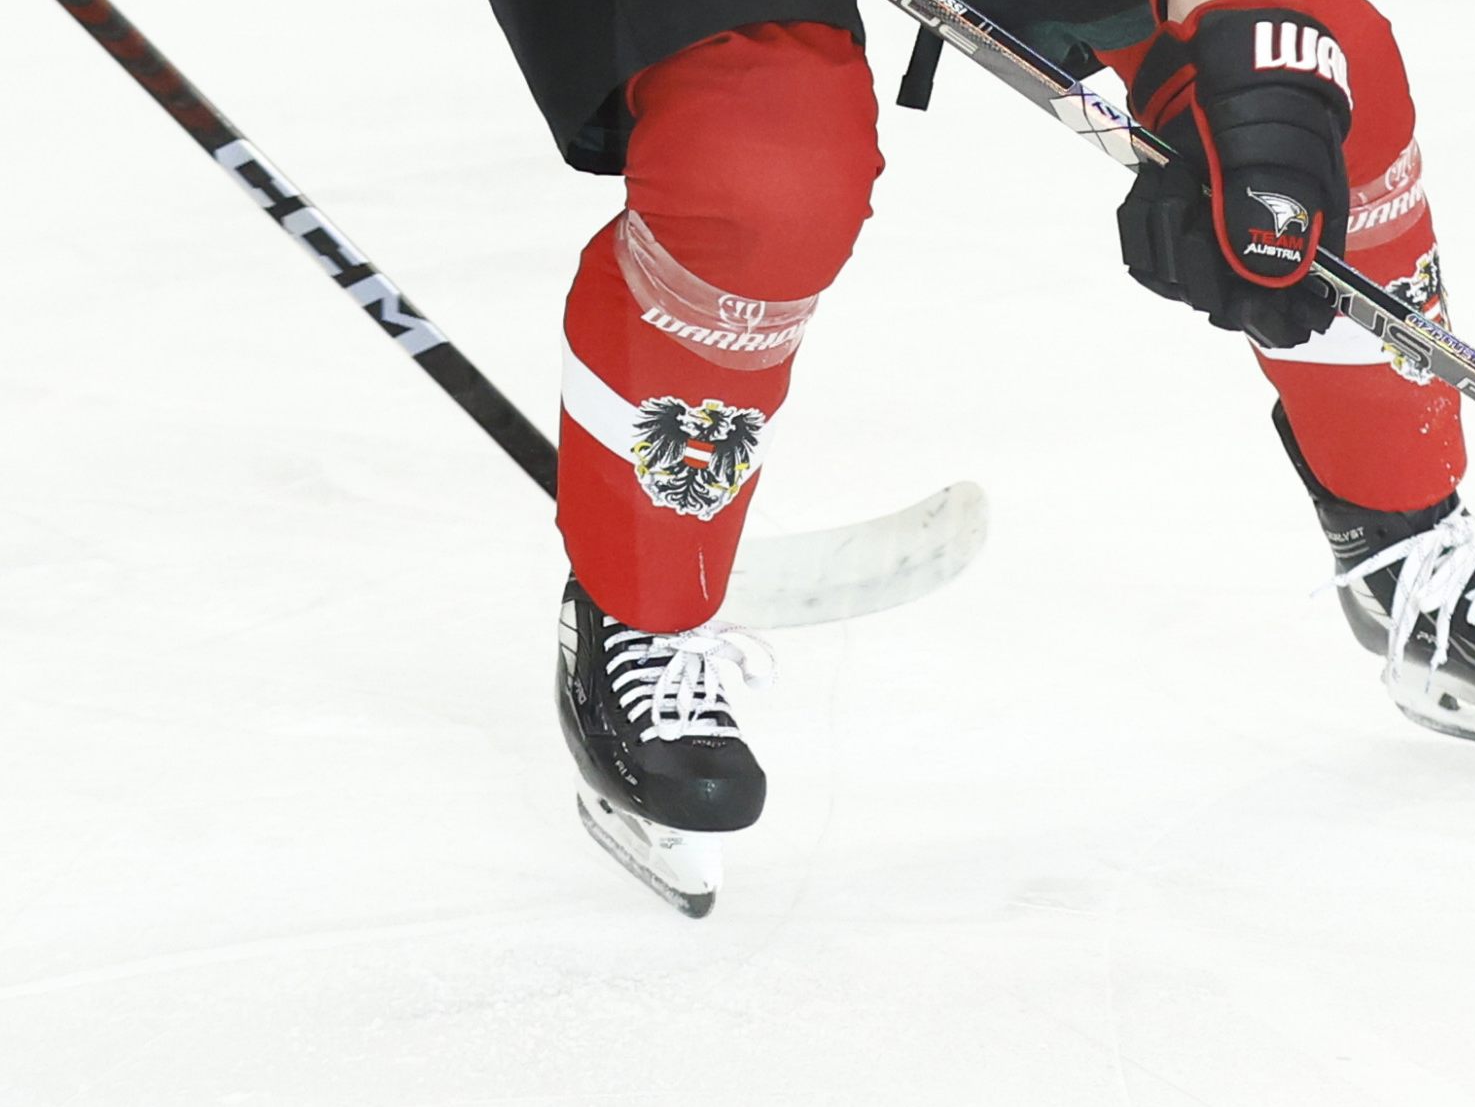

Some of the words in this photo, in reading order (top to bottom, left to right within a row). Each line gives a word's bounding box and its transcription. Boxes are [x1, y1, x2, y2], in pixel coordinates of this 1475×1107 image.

[1255, 21, 1354, 111] WA
[214, 138, 450, 358] CCM
[1243, 242, 1301, 263] AUSTRIA
[1248, 228, 1304, 249] TEAM
